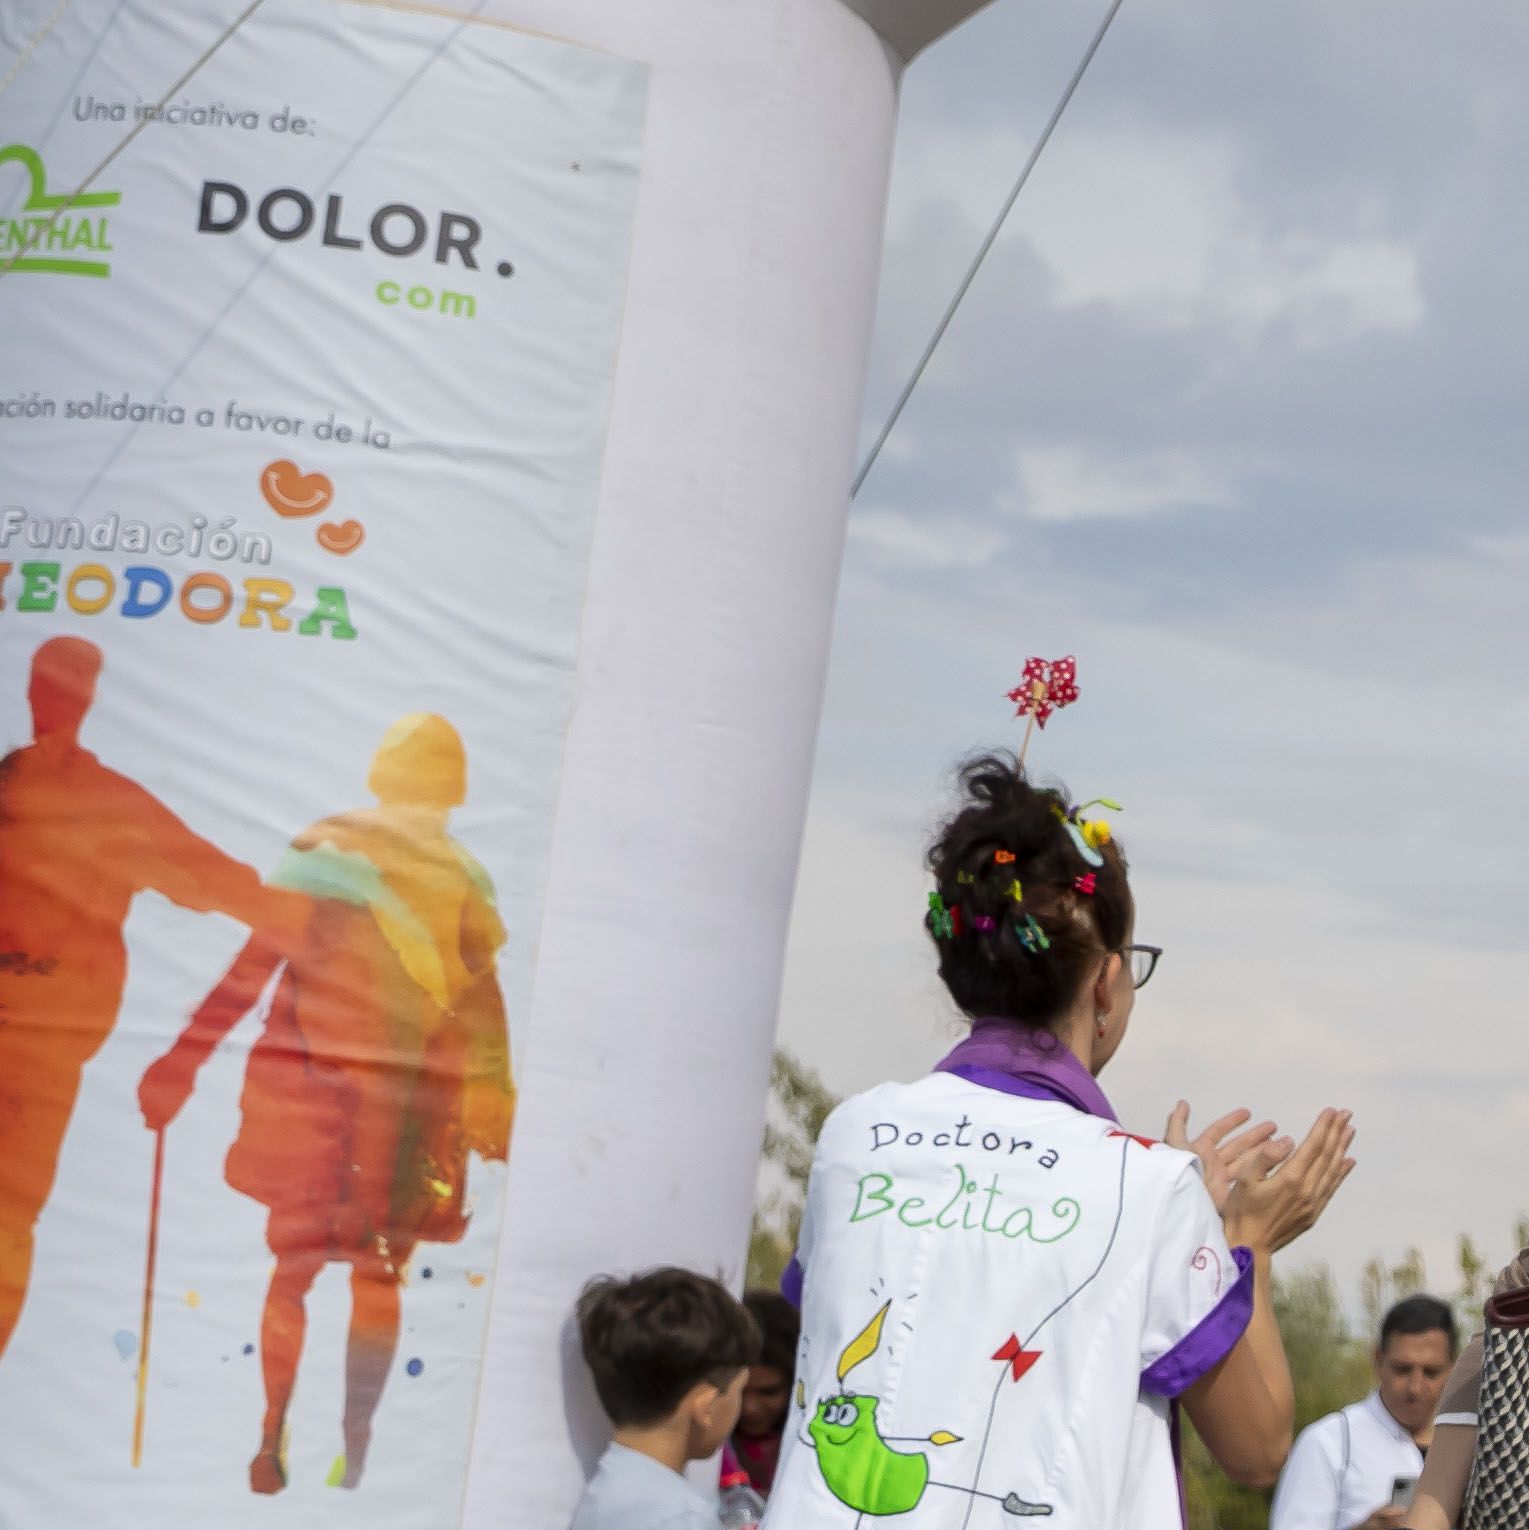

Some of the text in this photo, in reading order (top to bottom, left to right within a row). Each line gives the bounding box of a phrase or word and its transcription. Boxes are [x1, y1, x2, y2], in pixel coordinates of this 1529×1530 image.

[72, 97, 126, 122] Una
[134, 96, 259, 131] iniciativa
[375, 280, 477, 319] com
[64, 391, 186, 425] solidaria
[195, 408, 214, 427] a
[225, 402, 302, 437] favor
[313, 414, 353, 443] de
[362, 418, 392, 450] la
[0, 506, 272, 566] Fundación
[0, 560, 358, 641] EODORA
[869, 1114, 1061, 1170] Doctora
[849, 1163, 1081, 1244] Belita
